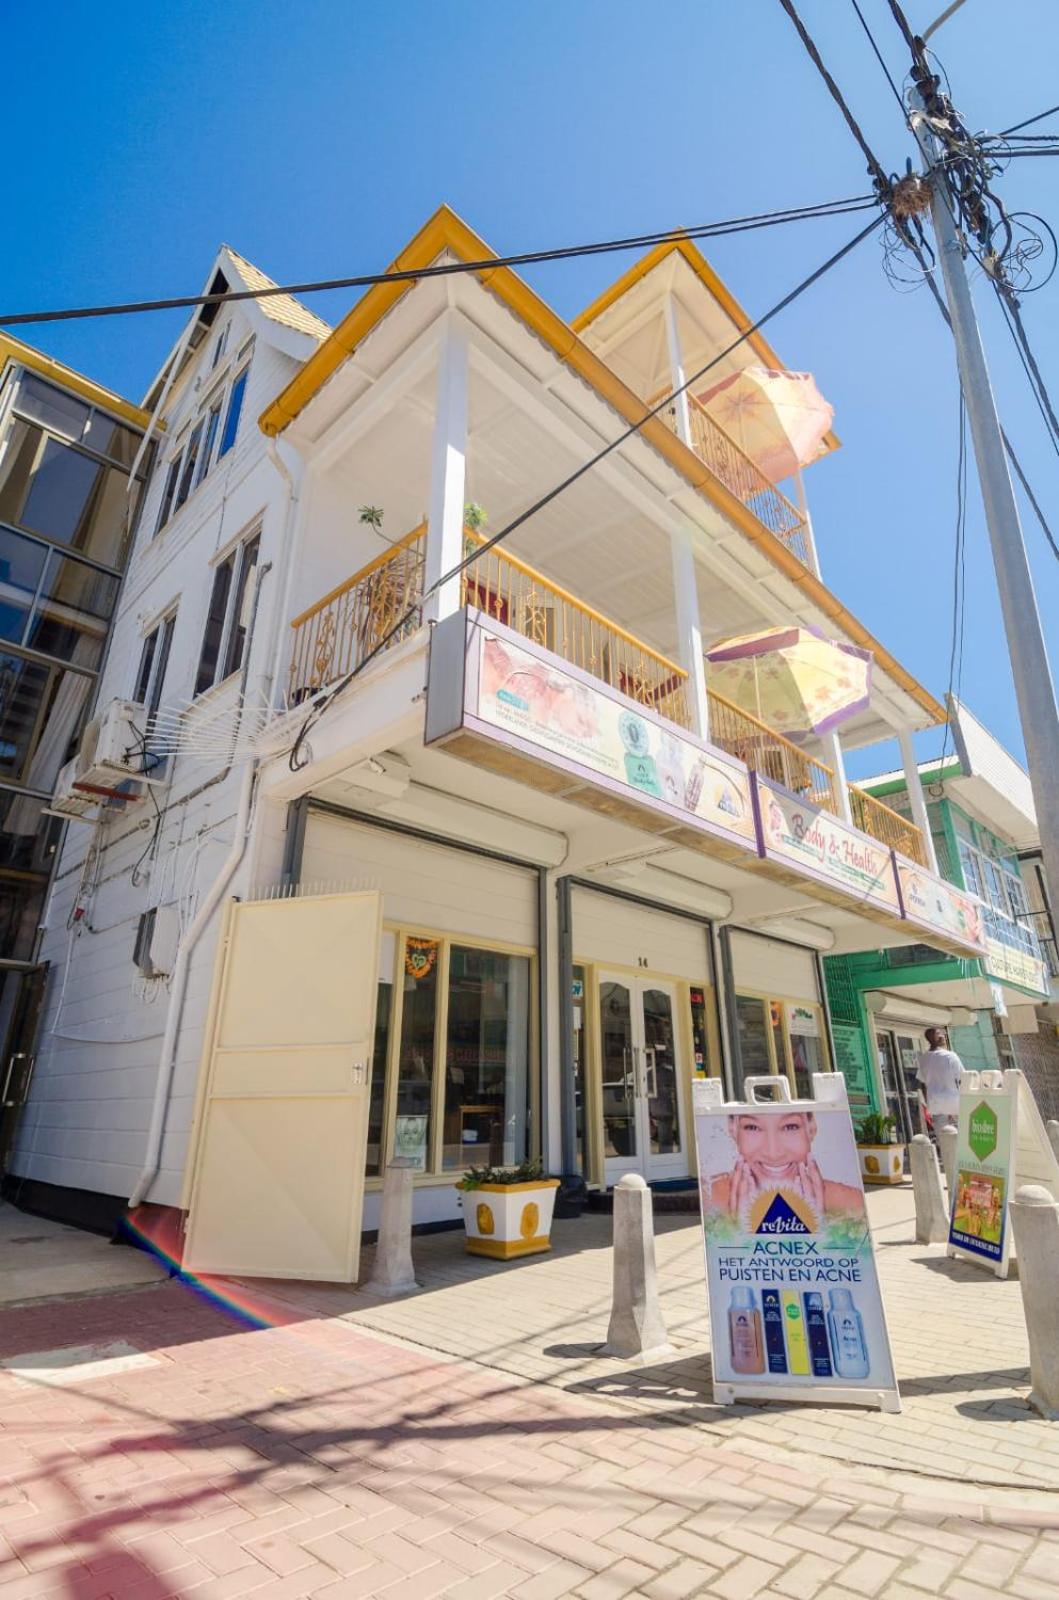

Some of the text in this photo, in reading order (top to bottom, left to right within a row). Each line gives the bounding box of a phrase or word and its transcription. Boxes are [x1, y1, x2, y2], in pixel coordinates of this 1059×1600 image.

[792, 814, 825, 863] Body
[842, 841, 878, 875] Health
[753, 1241, 819, 1255] ACNEX
[718, 1258, 858, 1267] HET ANTWOORD OP
[719, 1268, 862, 1282] PUISTEN EN ACNE
